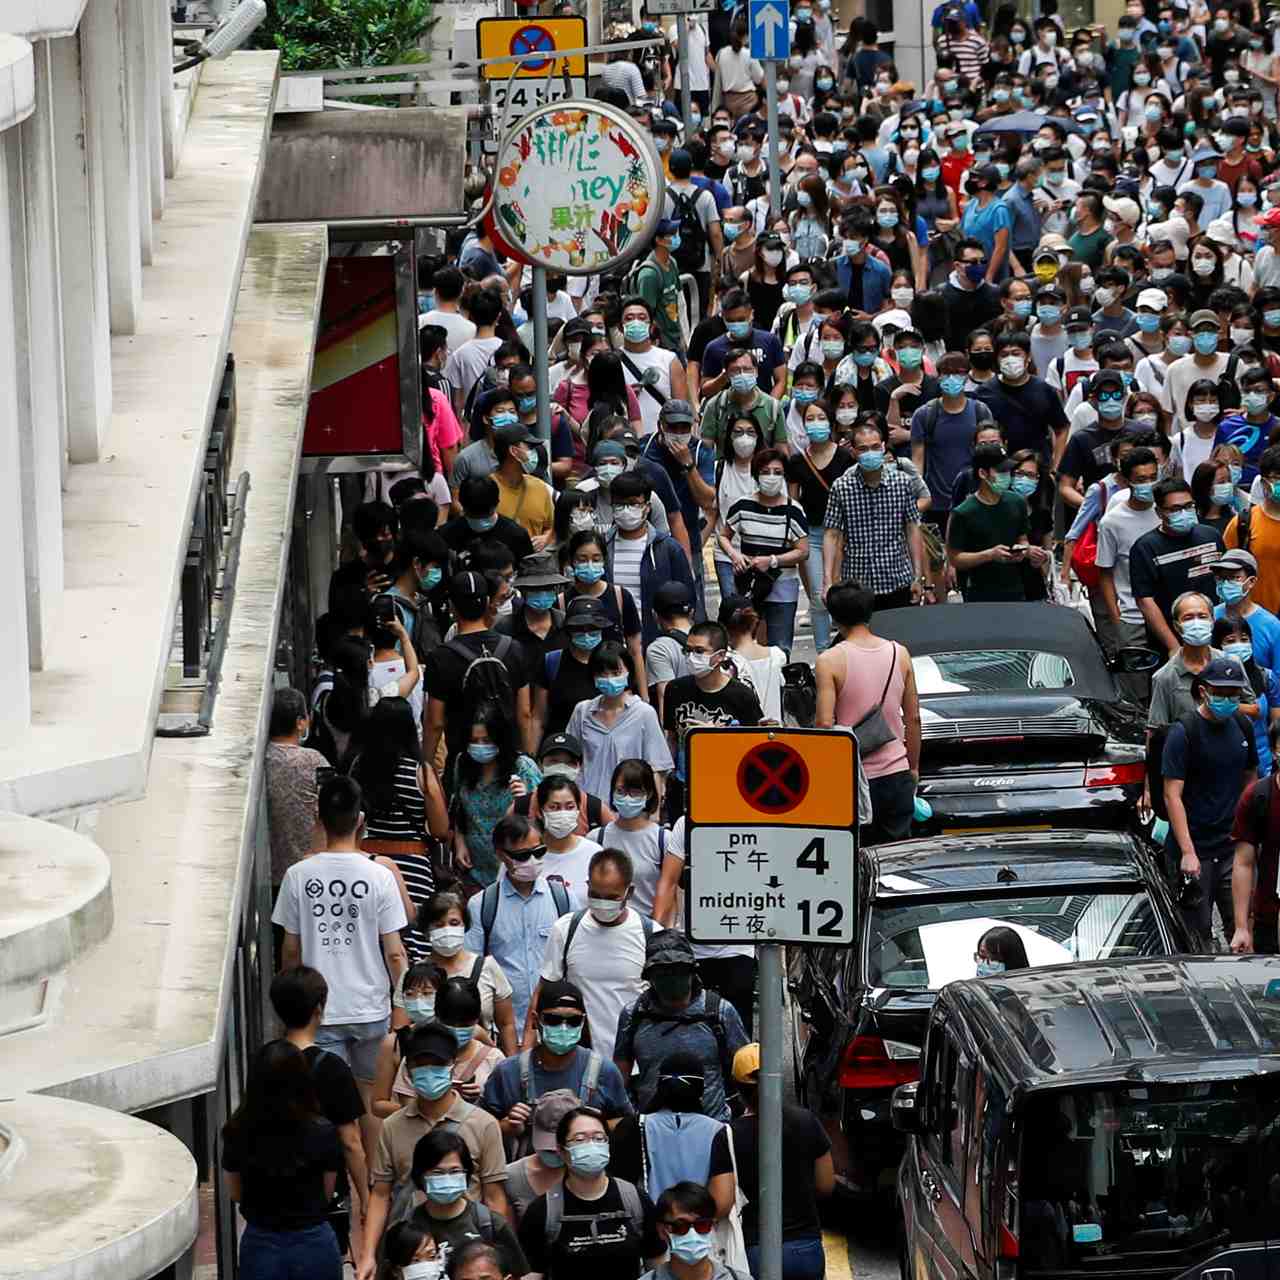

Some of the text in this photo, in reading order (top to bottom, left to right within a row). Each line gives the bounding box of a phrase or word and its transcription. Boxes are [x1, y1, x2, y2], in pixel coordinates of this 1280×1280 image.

[495, 88, 528, 108] 24
[728, 831, 757, 851] pm
[715, 851, 769, 873] 下午
[795, 836, 830, 876] 4
[698, 892, 786, 914] midnight
[718, 912, 767, 934] 午夜
[797, 899, 844, 937] 12
